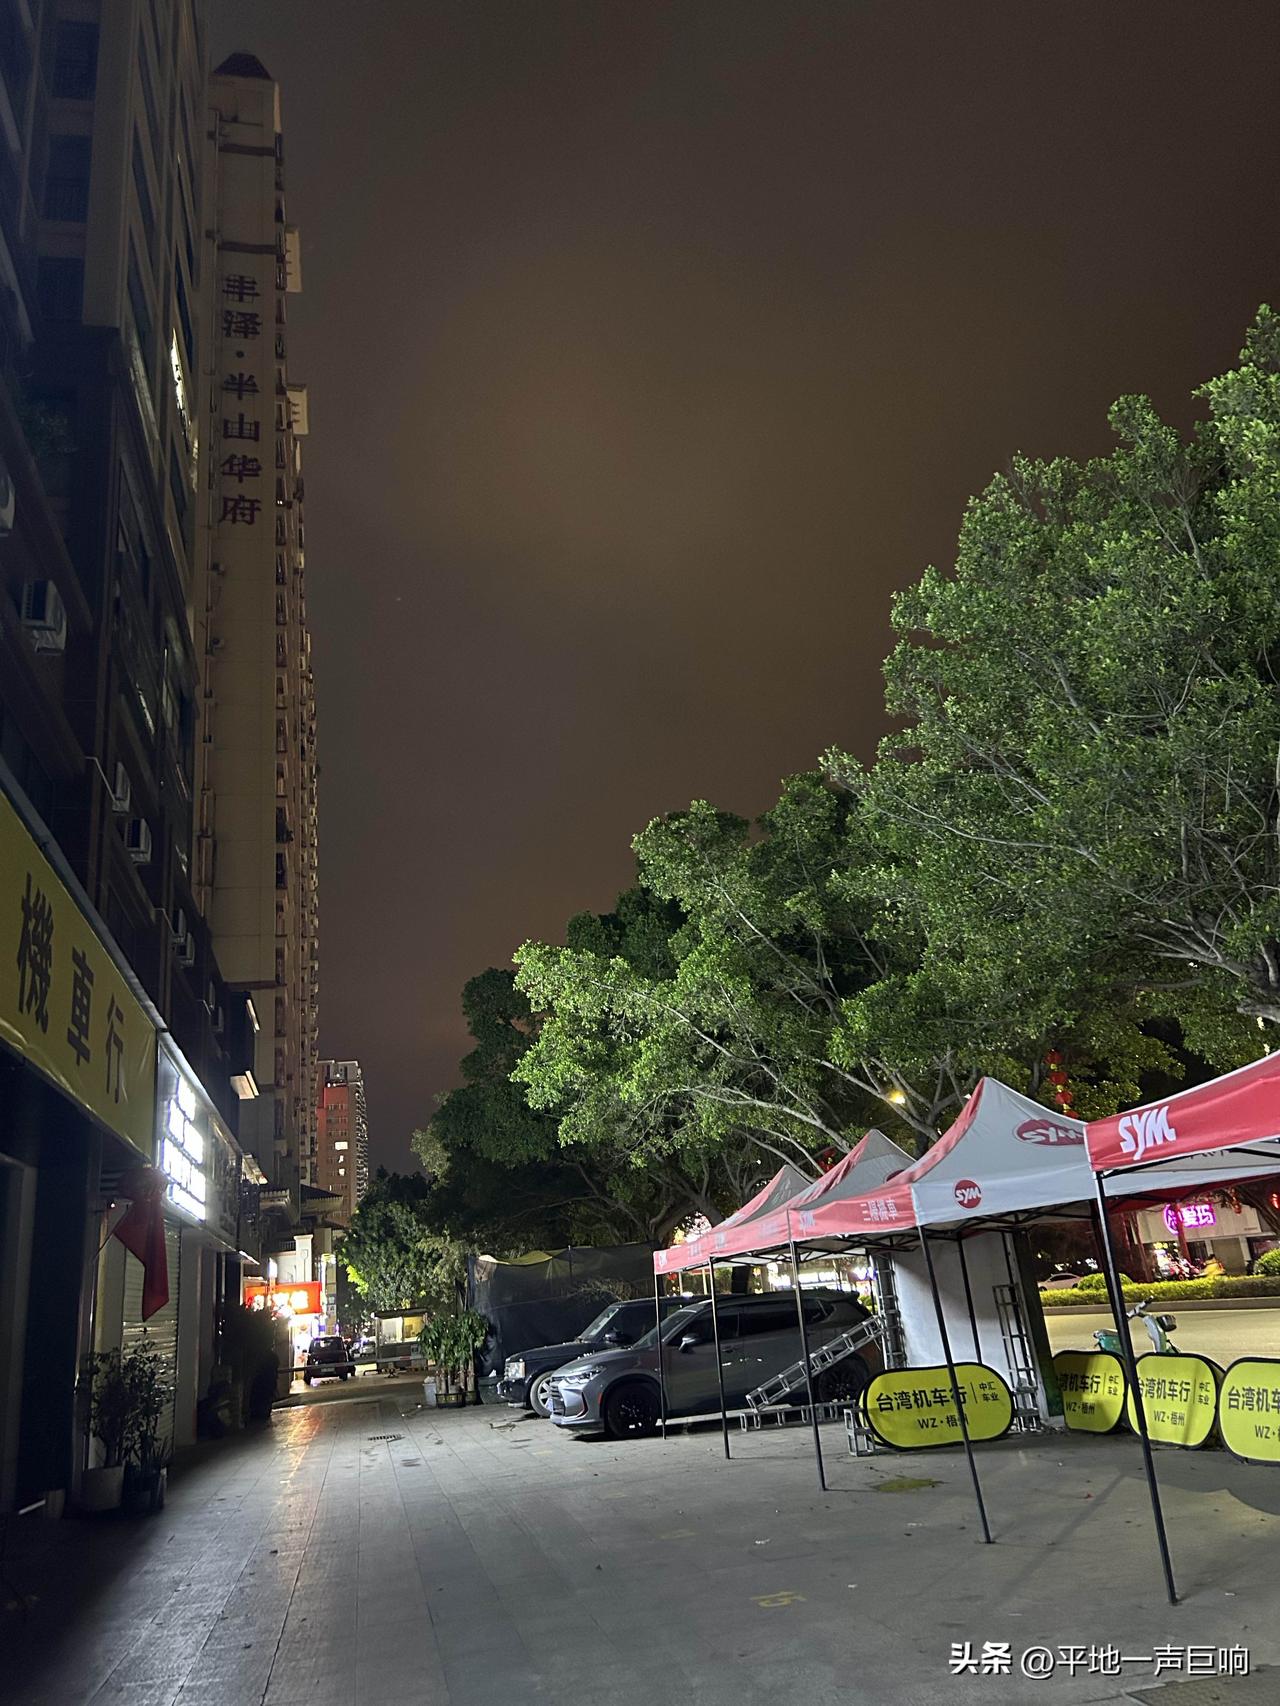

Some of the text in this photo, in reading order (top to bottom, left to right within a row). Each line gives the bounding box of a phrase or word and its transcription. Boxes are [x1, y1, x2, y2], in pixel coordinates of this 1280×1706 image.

[220, 275, 262, 525] 丰泽·半山华府
[17, 871, 125, 1104] 機車行
[1117, 1105, 1177, 1161] SYM
[955, 1186, 982, 1204] SYM
[979, 1381, 997, 1391] 中汇
[1056, 1373, 1101, 1394] 湾机车行
[1254, 1424, 1280, 1442] WZ·
